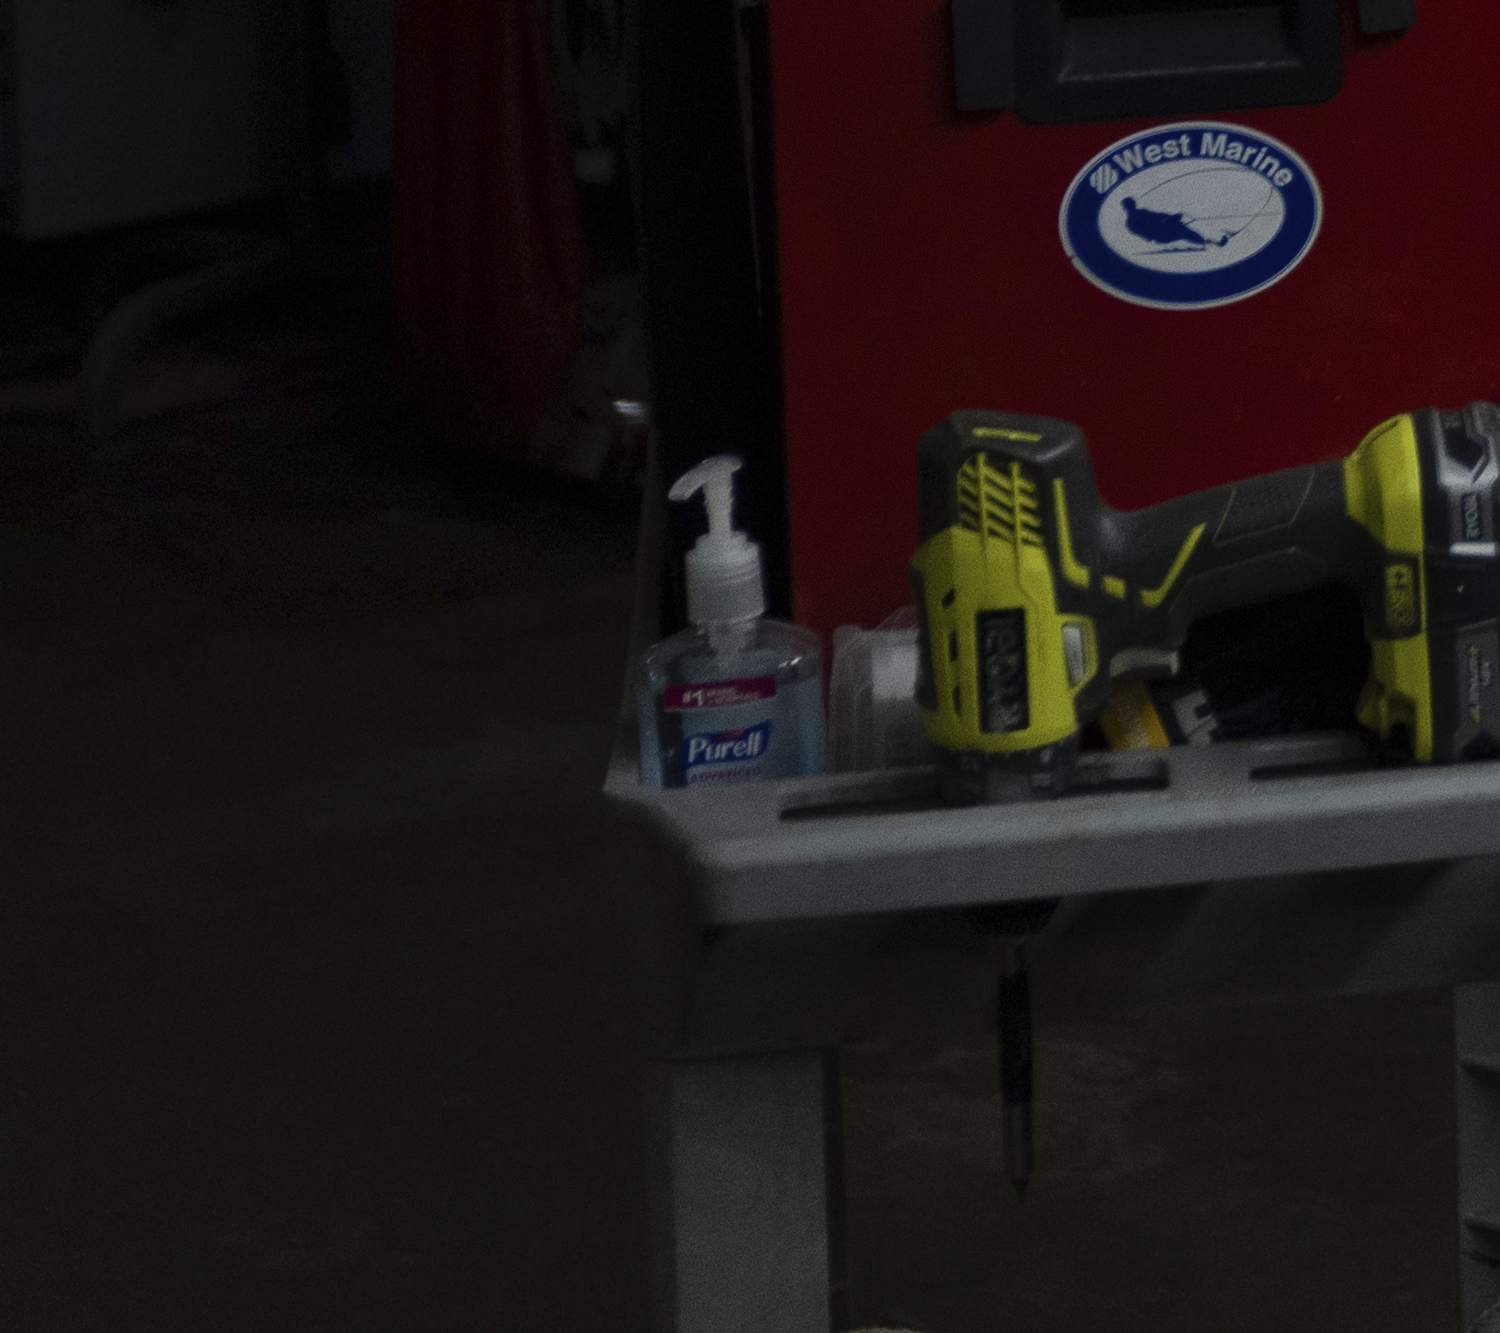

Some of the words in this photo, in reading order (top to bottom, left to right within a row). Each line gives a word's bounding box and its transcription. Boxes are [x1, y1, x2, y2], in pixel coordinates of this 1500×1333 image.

[1112, 133, 1192, 175] West
[1199, 132, 1293, 188] Marine
[688, 729, 764, 764] Purell
